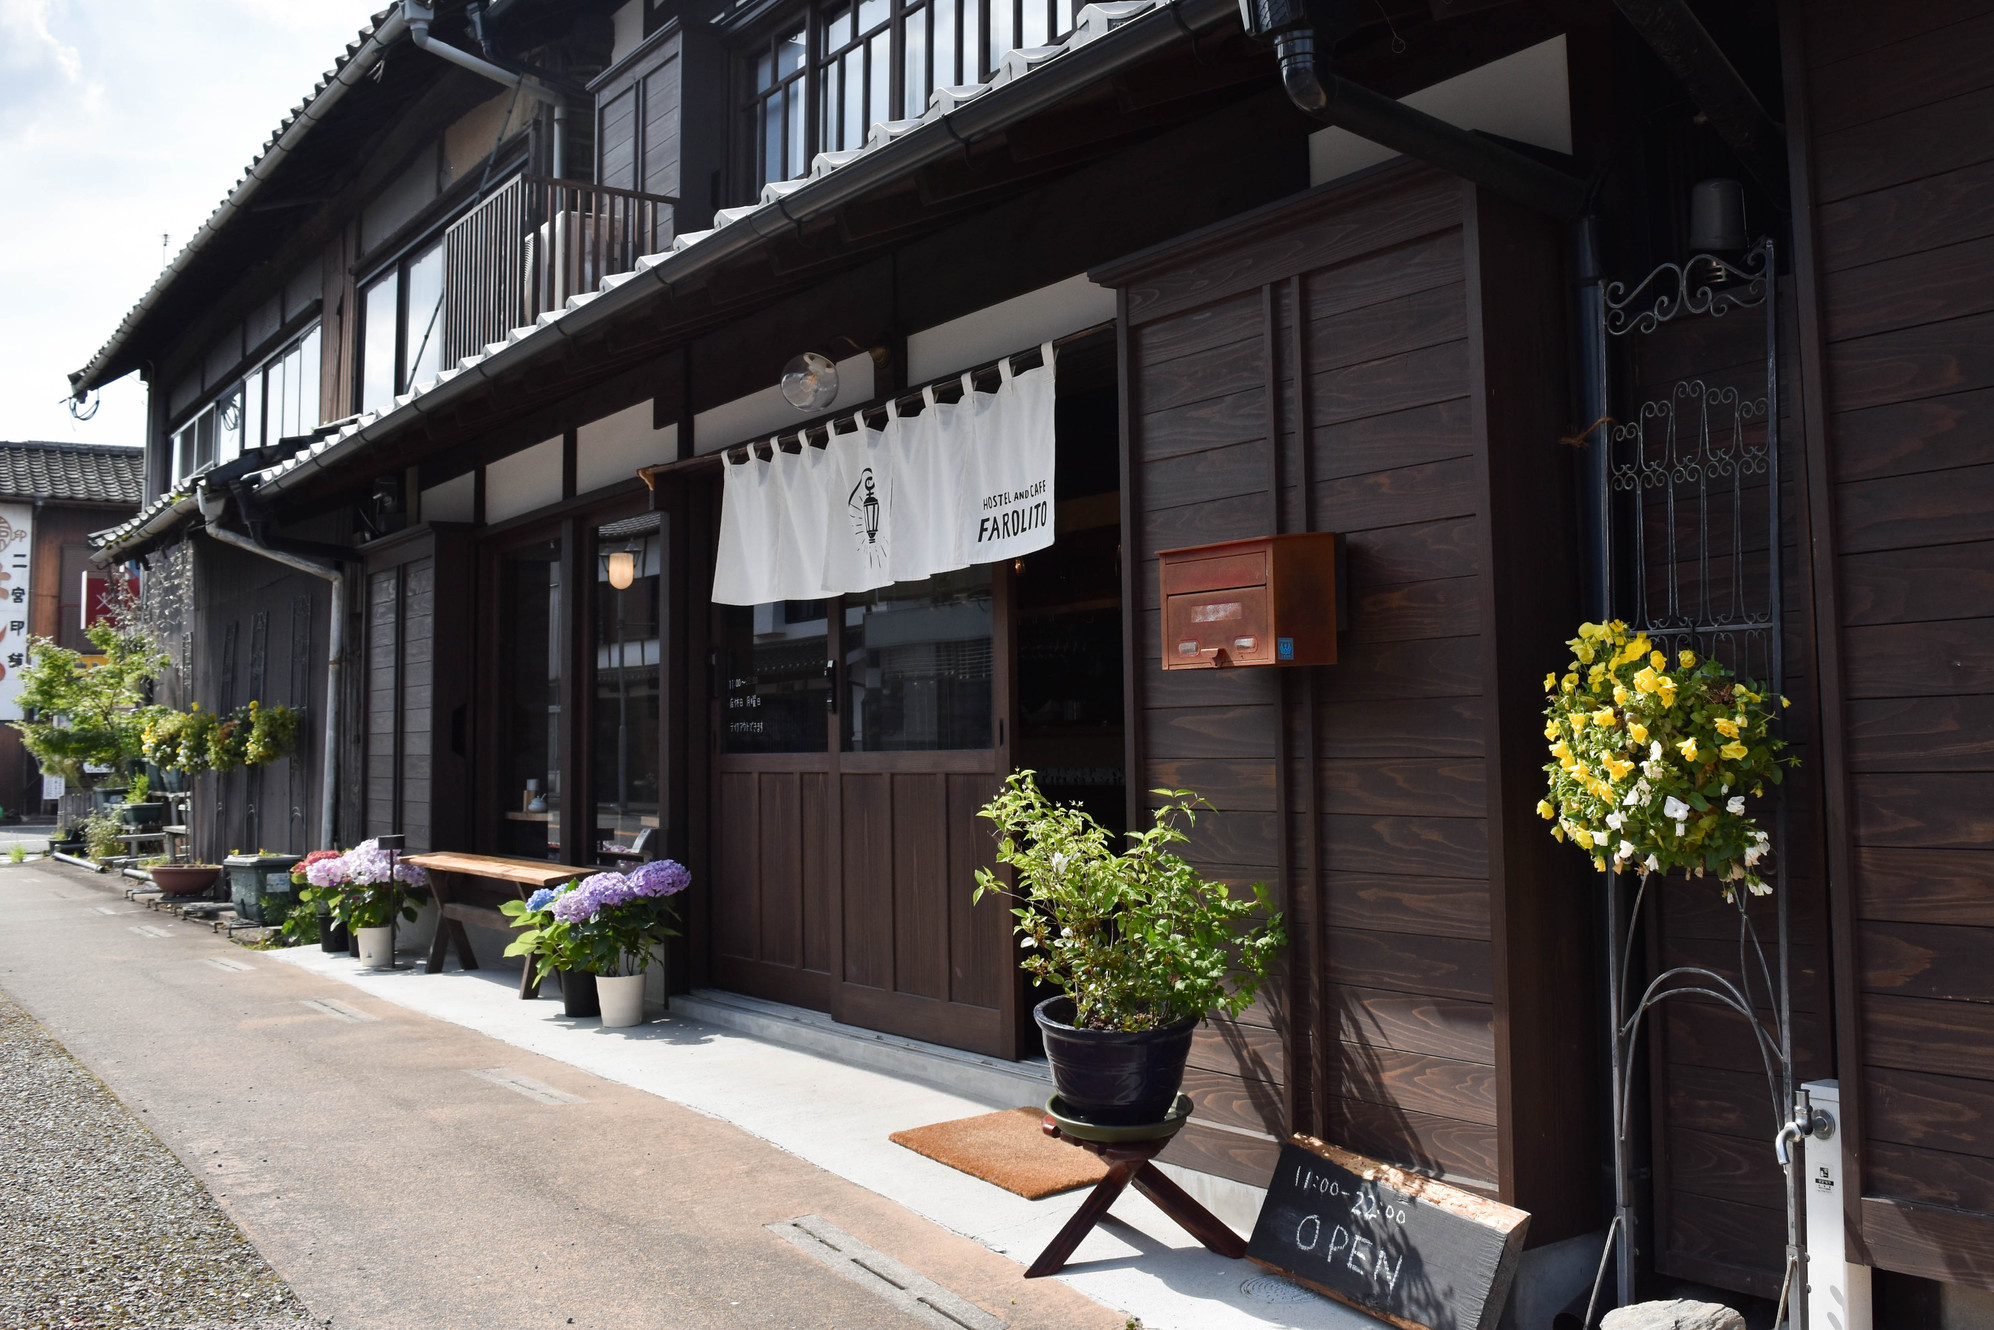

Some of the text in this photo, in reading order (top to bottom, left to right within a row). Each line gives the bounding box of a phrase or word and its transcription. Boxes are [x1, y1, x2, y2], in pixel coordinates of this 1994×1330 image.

[983, 480, 1046, 510] HOSTEL AND CAFE
[977, 501, 1047, 542] FAROLITO
[1294, 1165, 1406, 1225] 11:00-22:00
[1296, 1214, 1403, 1293] OPEN
